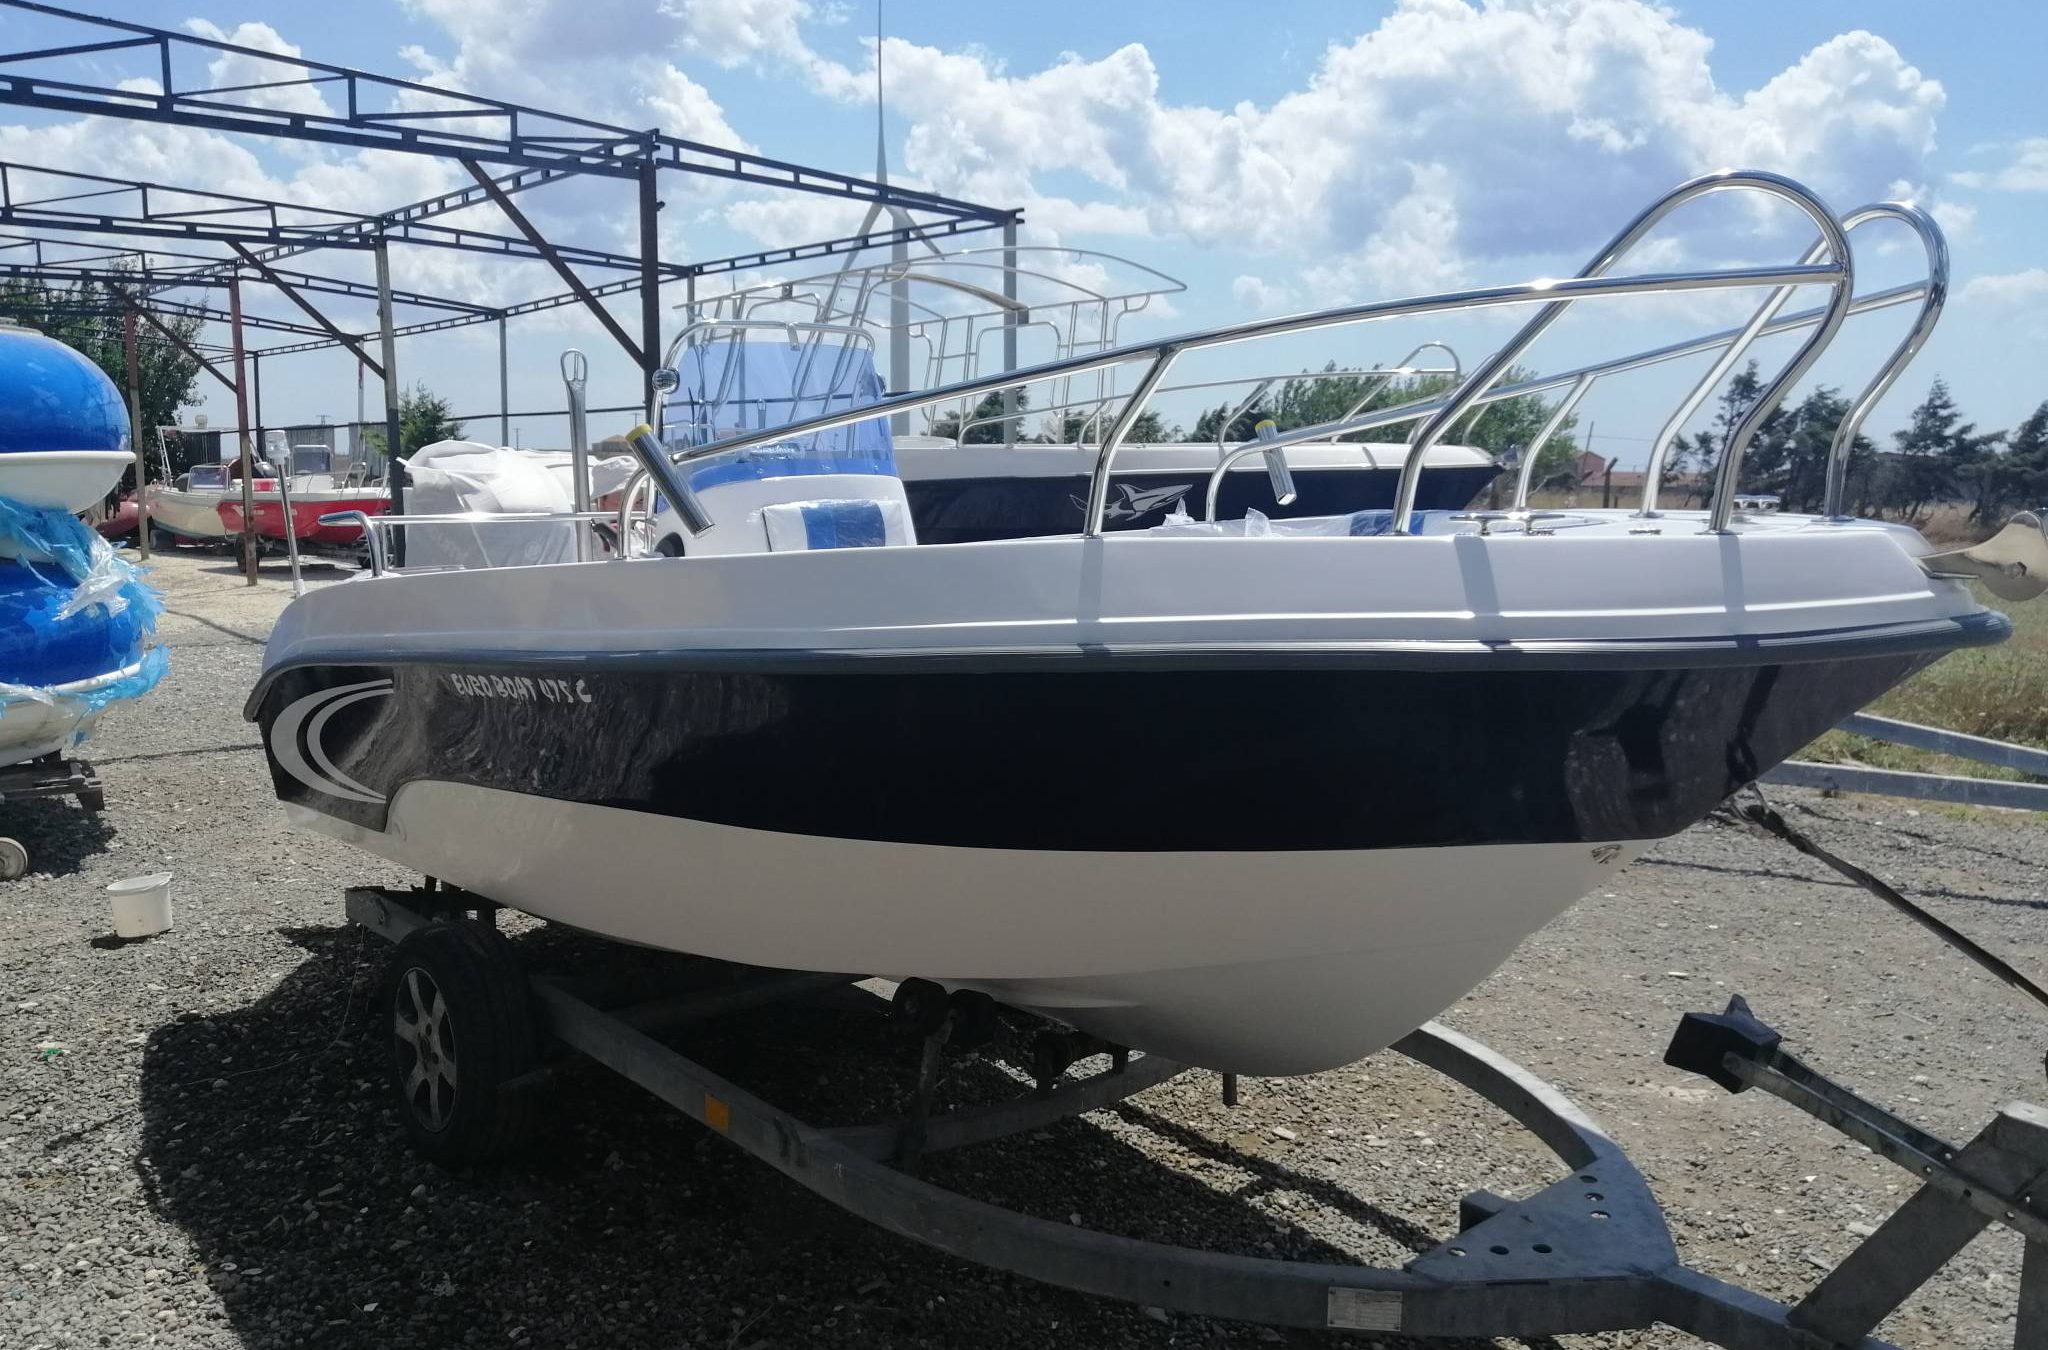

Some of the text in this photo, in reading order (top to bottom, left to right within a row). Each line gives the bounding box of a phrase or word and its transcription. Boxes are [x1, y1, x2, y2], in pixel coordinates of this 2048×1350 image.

[450, 673, 493, 698] EURO
[489, 674, 537, 702] BOAT
[537, 678, 575, 703] 475
